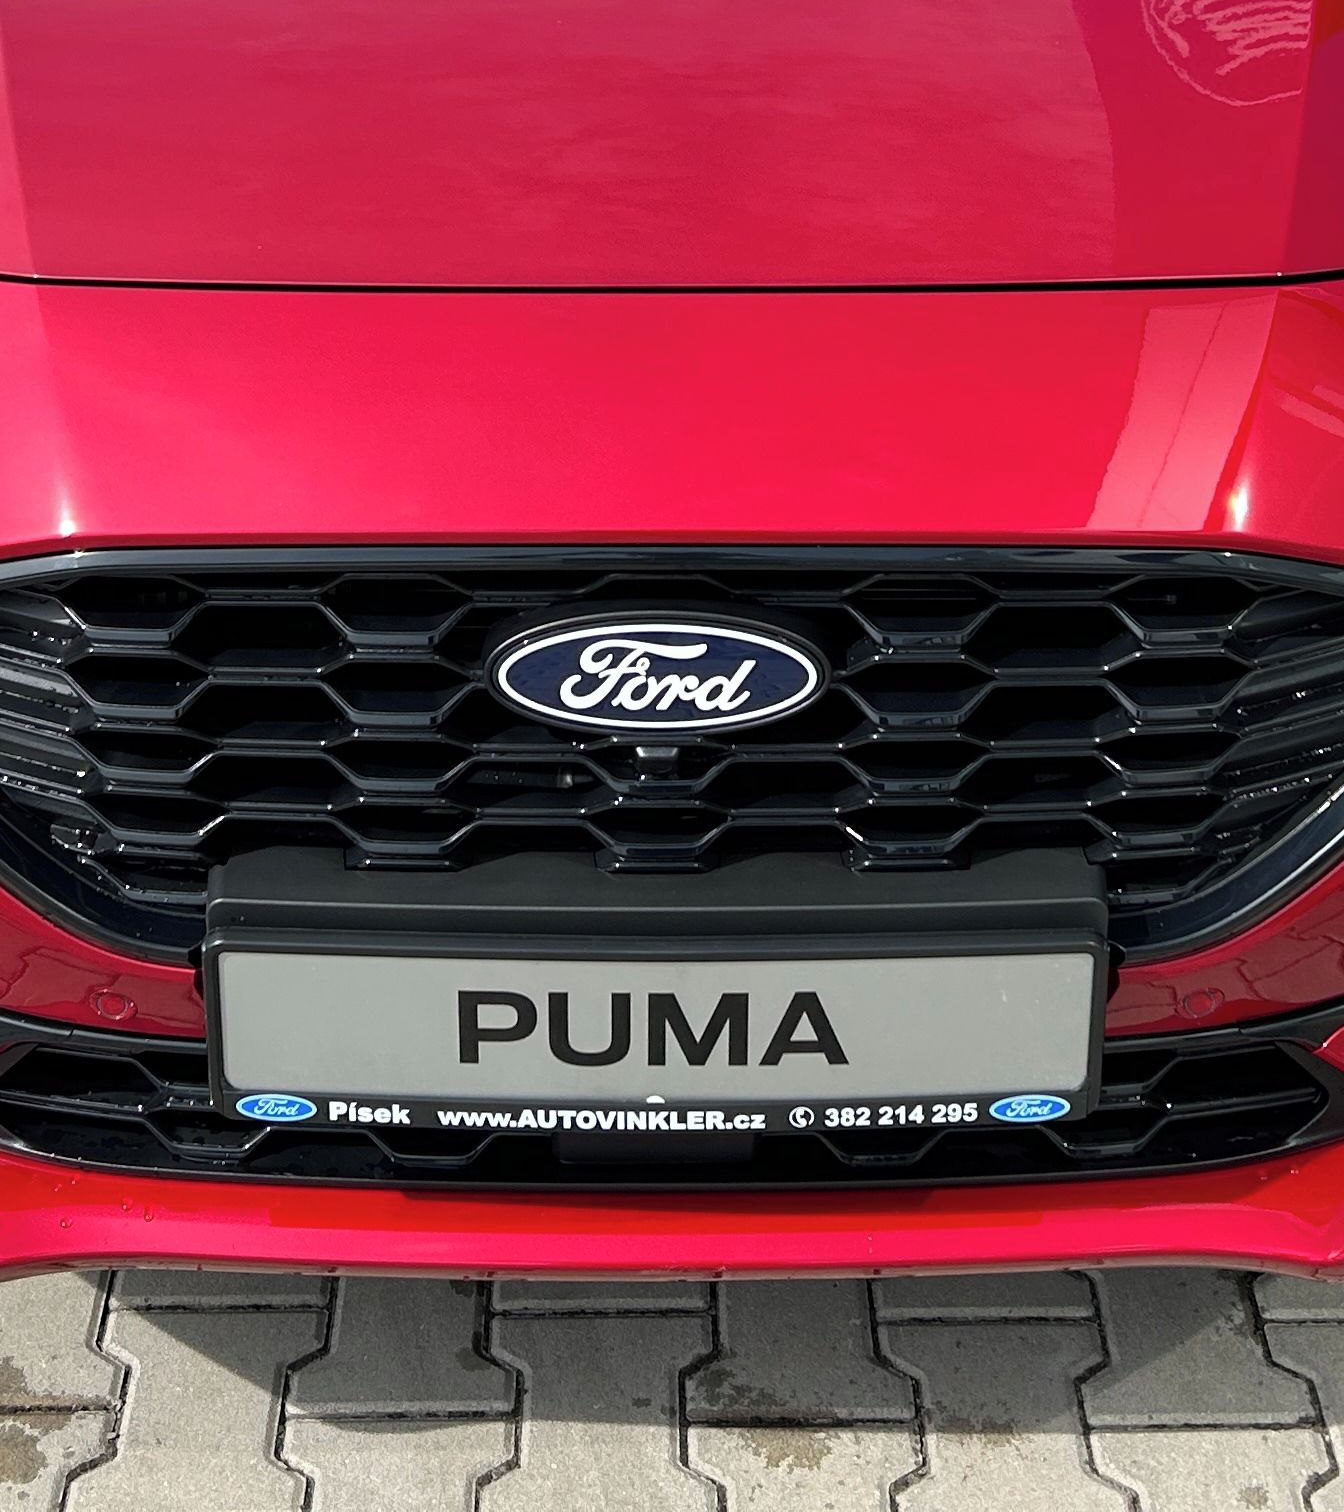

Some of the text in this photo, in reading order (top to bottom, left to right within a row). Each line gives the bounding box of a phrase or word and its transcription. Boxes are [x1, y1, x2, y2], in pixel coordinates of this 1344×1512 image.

[559, 638, 757, 712] Ford
[456, 988, 851, 1068] PUMA
[252, 1098, 1055, 1132] Ford Písek www.AUTOVINKLER.cz 382 214 295 Ford
